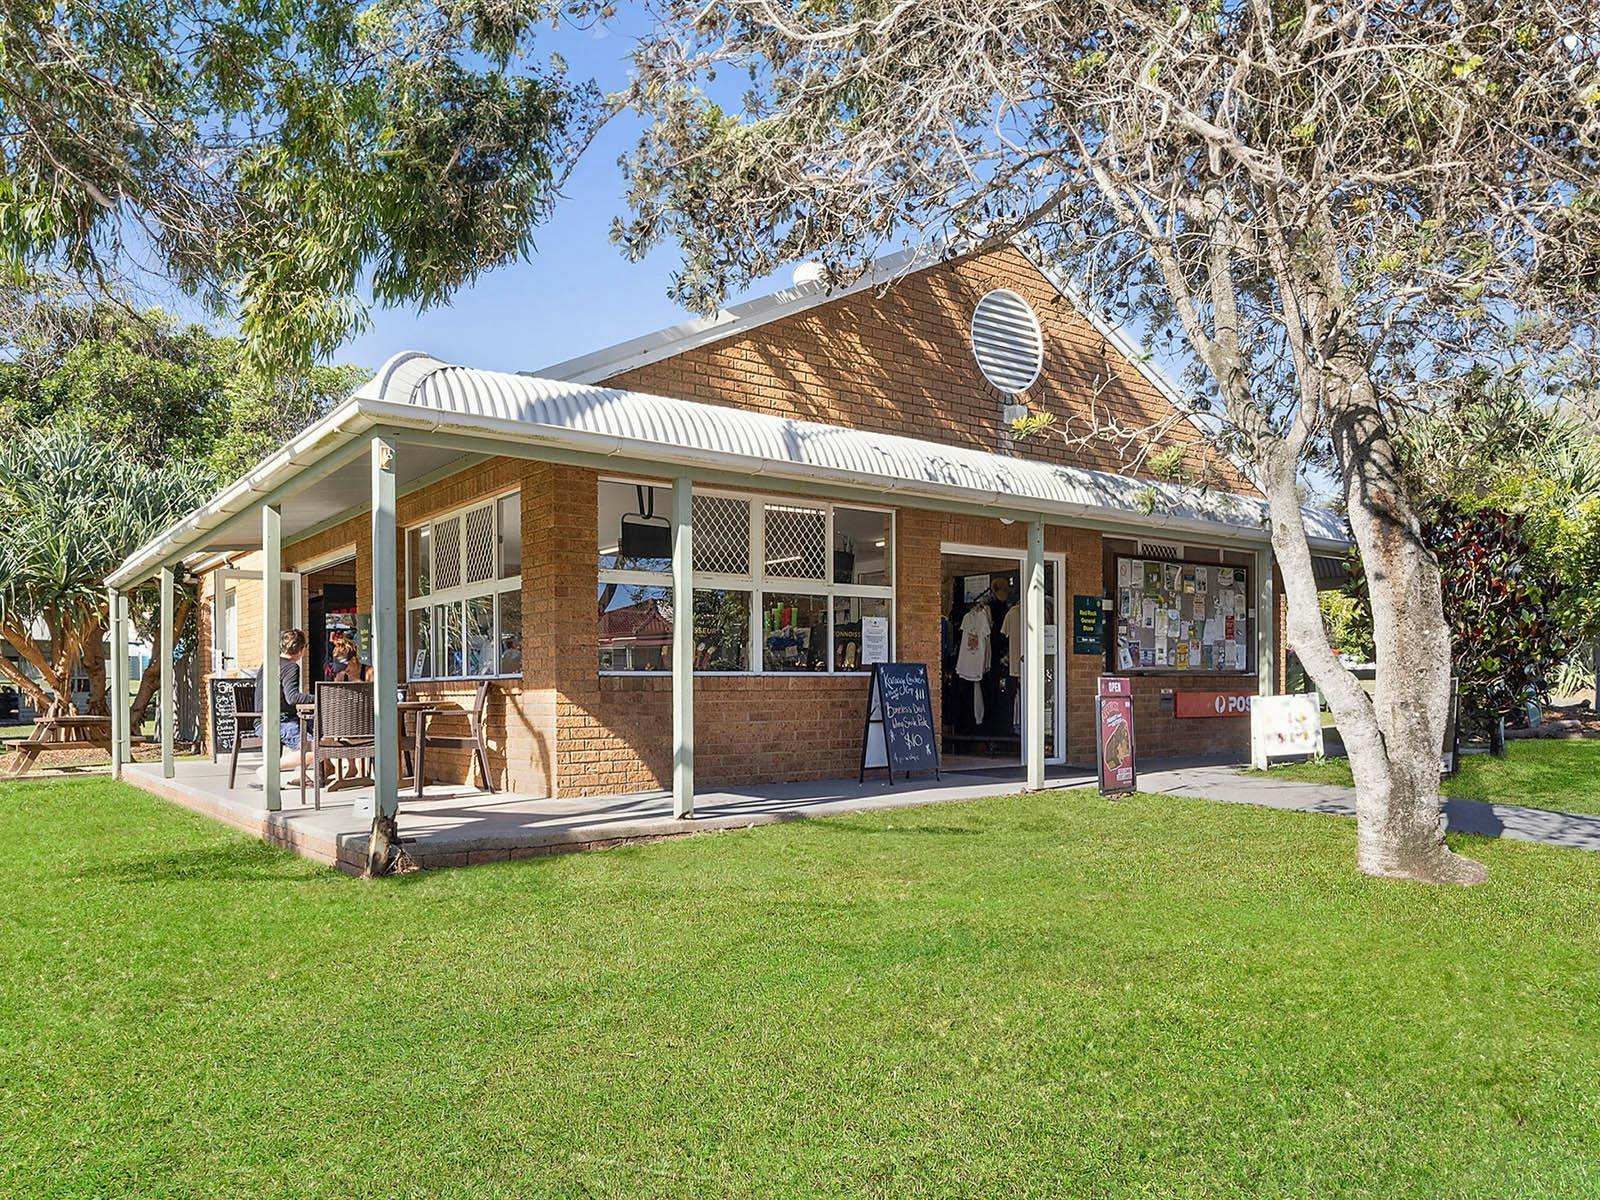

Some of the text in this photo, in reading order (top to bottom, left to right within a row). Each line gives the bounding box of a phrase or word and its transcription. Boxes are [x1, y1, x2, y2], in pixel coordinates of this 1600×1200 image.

[1108, 682, 1121, 692] OPEN
[1228, 695, 1250, 713] POS
[904, 733, 923, 750] $10
